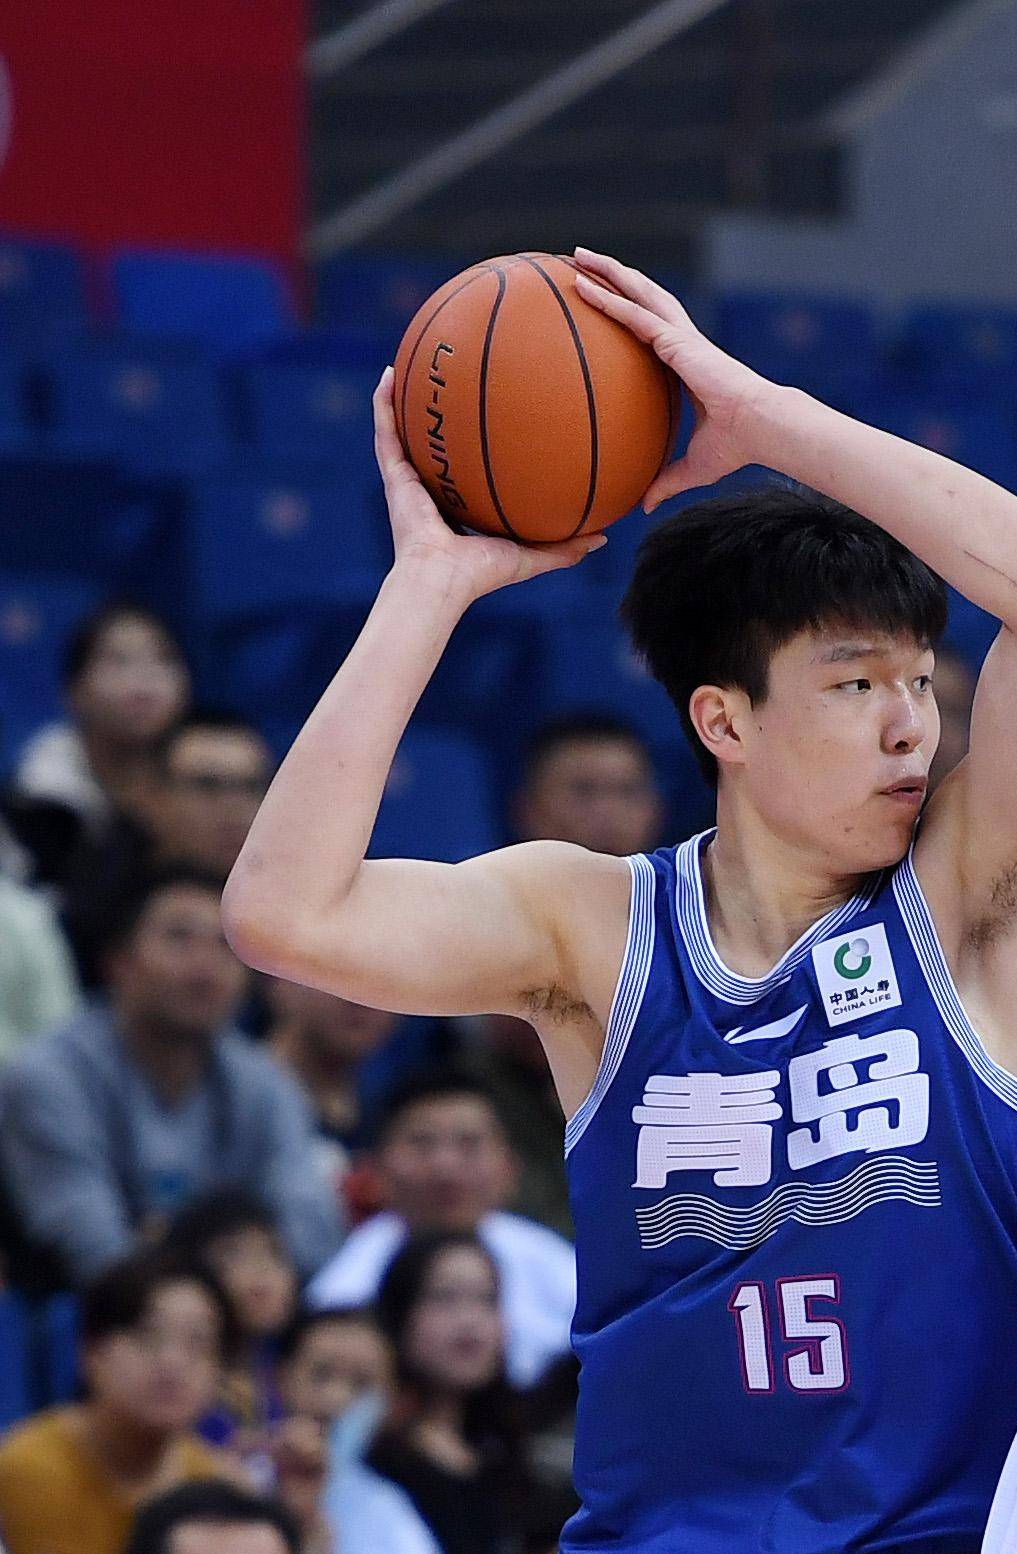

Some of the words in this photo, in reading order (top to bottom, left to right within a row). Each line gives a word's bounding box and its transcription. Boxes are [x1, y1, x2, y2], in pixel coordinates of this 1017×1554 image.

[426, 341, 467, 512] LI-NING
[832, 1000, 866, 1016] CHINA
[868, 993, 892, 1005] LIFE
[631, 1028, 929, 1188] 青岛
[728, 1273, 849, 1395] 15
